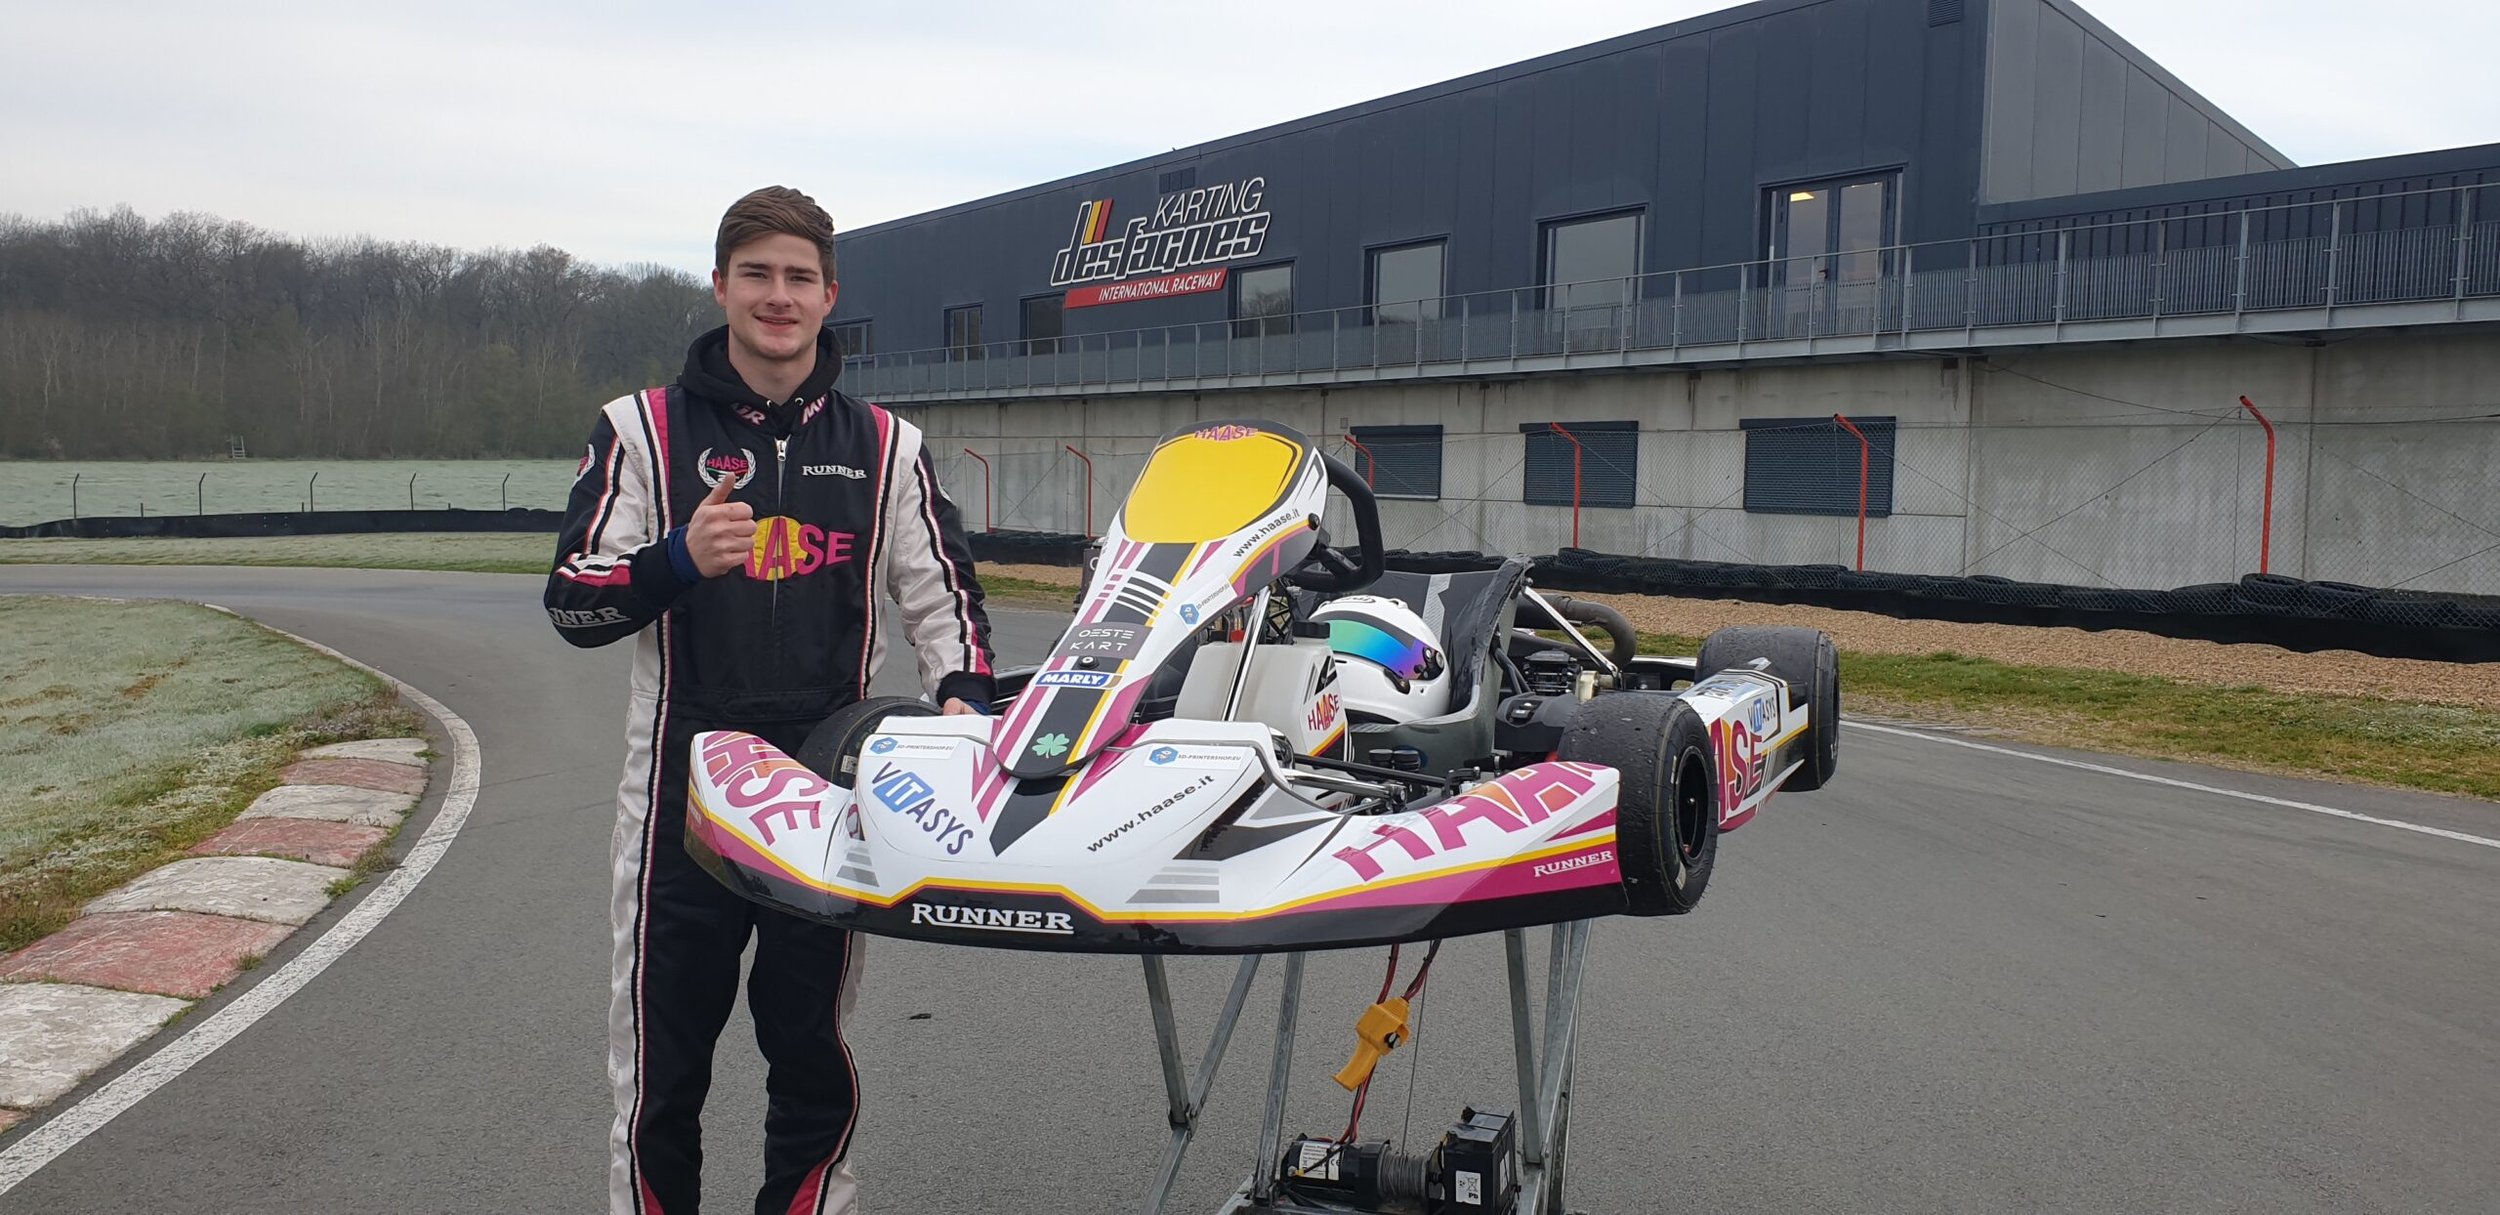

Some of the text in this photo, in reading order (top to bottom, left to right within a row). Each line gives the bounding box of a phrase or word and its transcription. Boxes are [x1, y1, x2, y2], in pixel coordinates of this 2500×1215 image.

[1152, 177, 1265, 229] KARTING
[1098, 272, 1221, 302] INTERNATIONAL RACEWAY
[1194, 425, 1258, 441] HAASE
[706, 455, 748, 470] HAASE
[801, 465, 867, 480] RUNNER
[1233, 508, 1300, 557] www.haase.it
[1069, 641, 1127, 651] KART
[1078, 628, 1135, 639] OESTE
[1041, 673, 1104, 686] MARLY
[1307, 693, 1340, 731] HAASE
[1747, 696, 1776, 731] VITASYS
[872, 761, 974, 855] VITASYS
[1087, 773, 1215, 853] www.haase.it
[1331, 761, 1609, 882] HAA
[1533, 850, 1614, 878] RUNNER
[911, 903, 1074, 935] RUNNER
